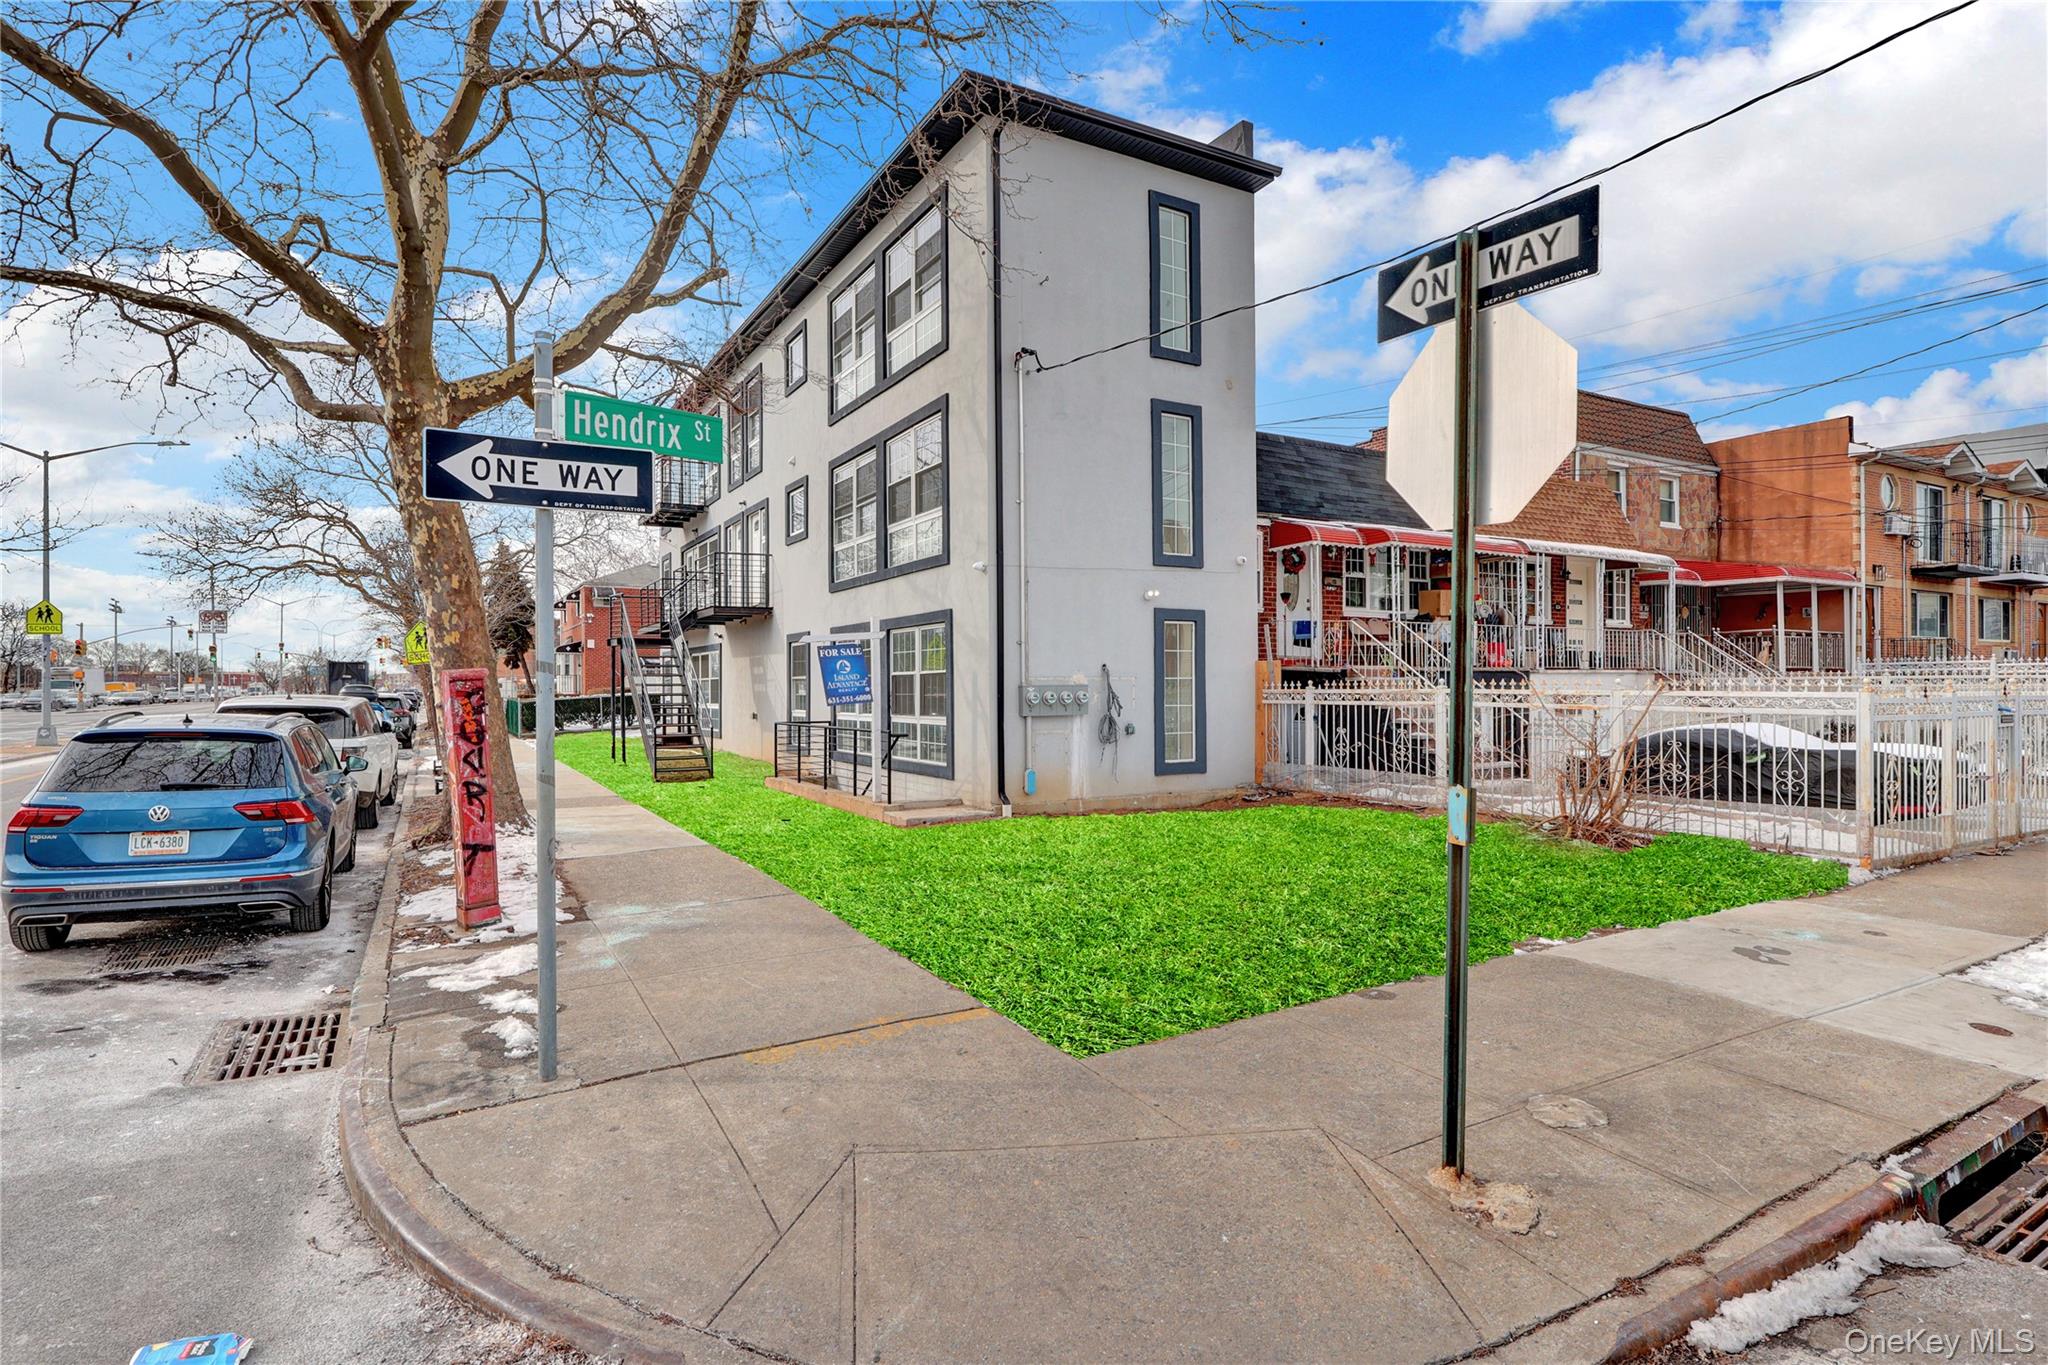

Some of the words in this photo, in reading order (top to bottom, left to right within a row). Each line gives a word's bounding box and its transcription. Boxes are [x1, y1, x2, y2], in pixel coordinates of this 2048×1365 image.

[1411, 266, 1456, 307] ON
[1489, 226, 1562, 279] WAY
[1484, 296, 1503, 306] DEPT
[1505, 291, 1515, 299] OF
[1518, 268, 1589, 295] TRANSPORTATION
[574, 399, 682, 450] Hendrix
[694, 420, 711, 442] St
[471, 455, 540, 486] ONE
[559, 463, 624, 492] WAY
[587, 504, 646, 512] TRANSPORTATION
[409, 652, 430, 661] SCHO
[820, 648, 839, 657] FOR
[840, 647, 862, 656] SALE
